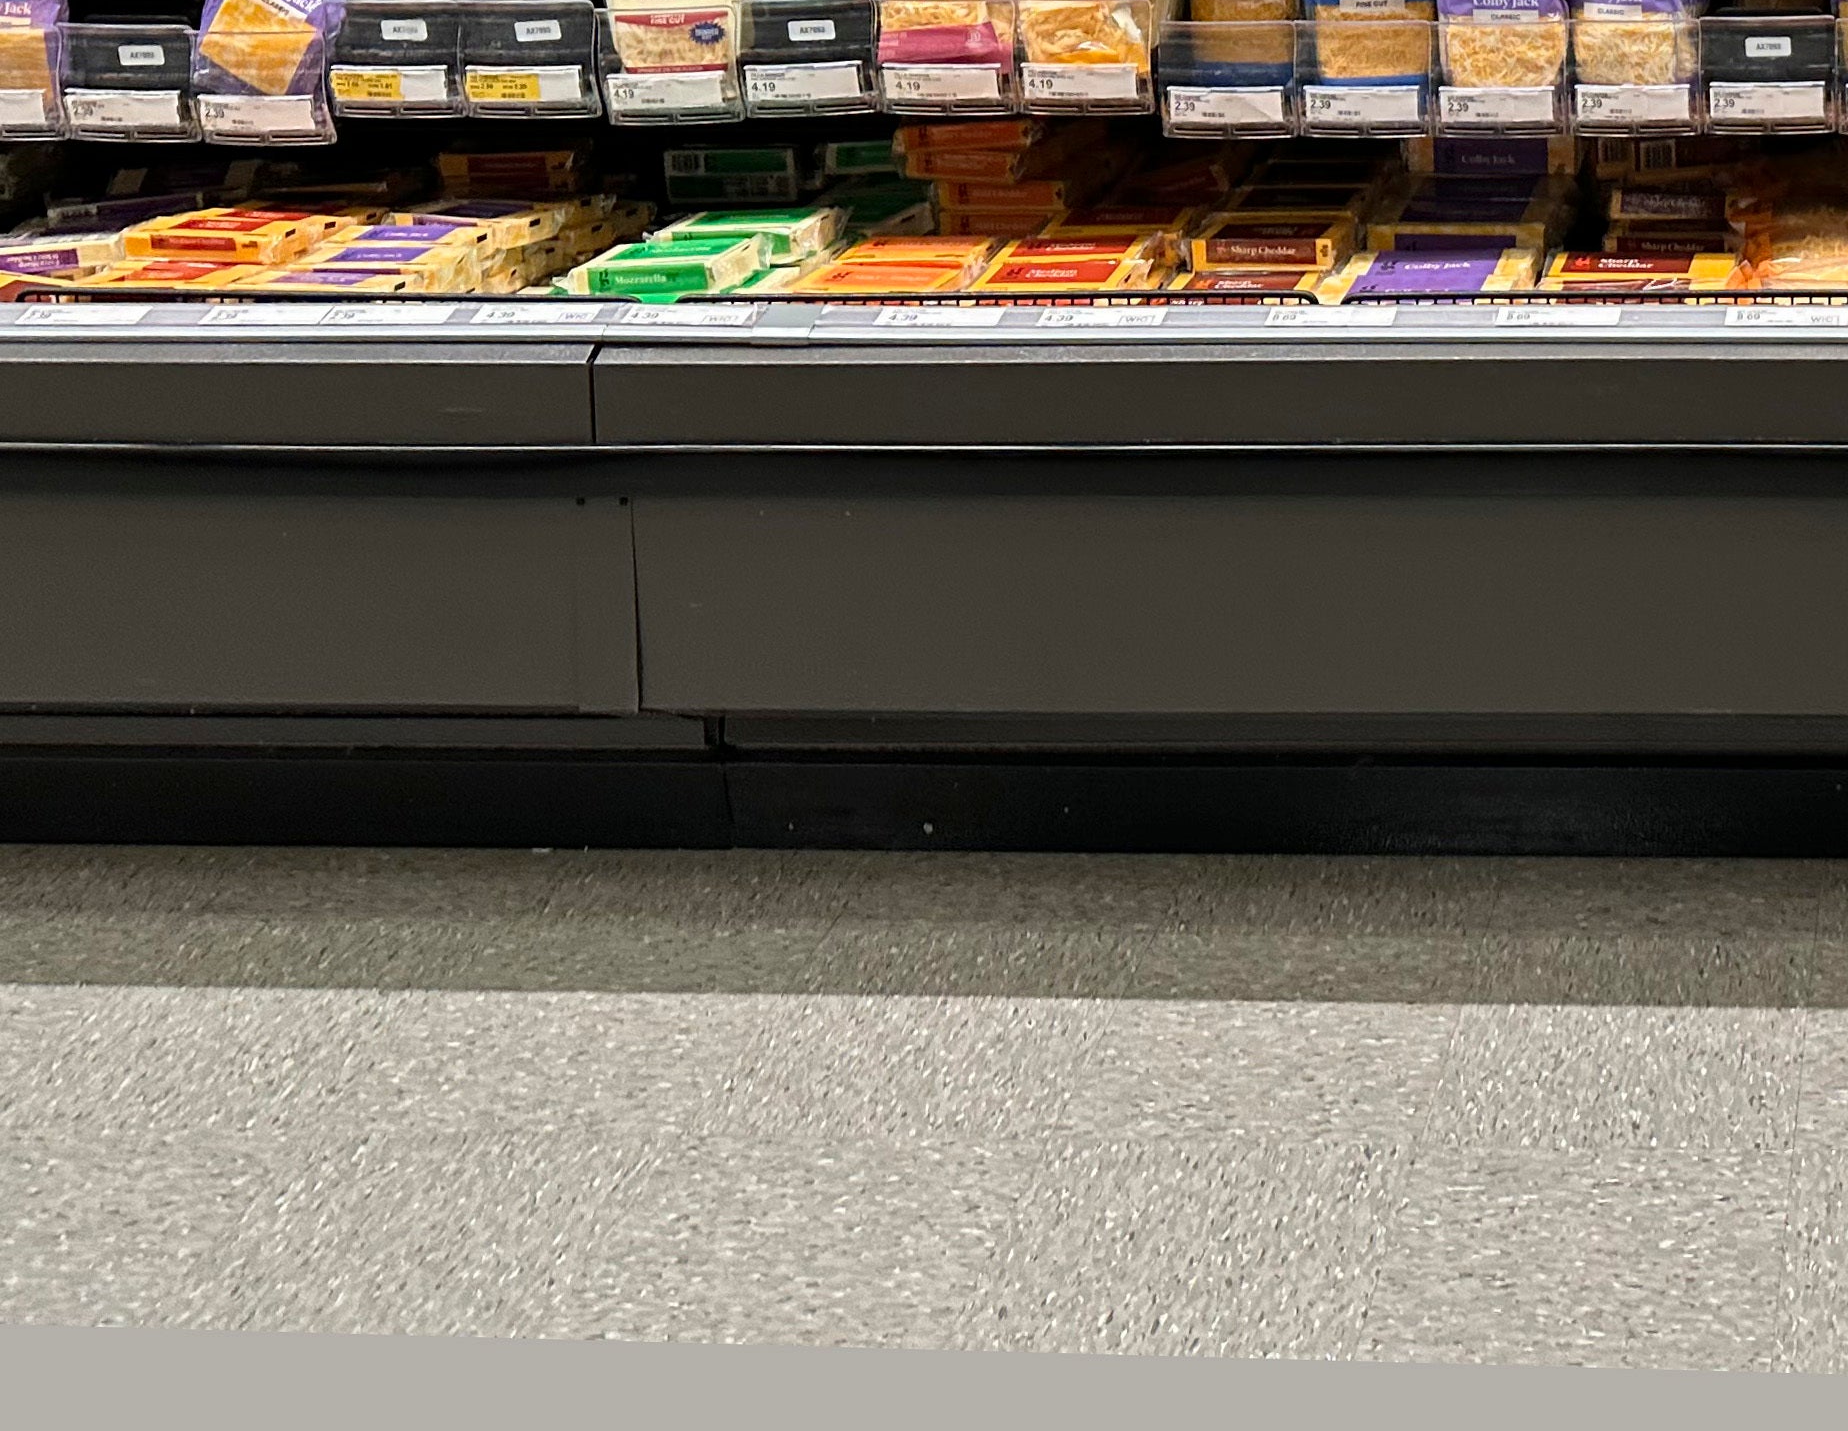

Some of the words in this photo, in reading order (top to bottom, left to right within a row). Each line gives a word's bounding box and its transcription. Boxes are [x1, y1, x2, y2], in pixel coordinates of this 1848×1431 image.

[752, 82, 775, 92] 4.19
[1230, 244, 1256, 256] Sharp
[1258, 245, 1296, 257] Cheddar
[614, 271, 667, 285] Mozzarella
